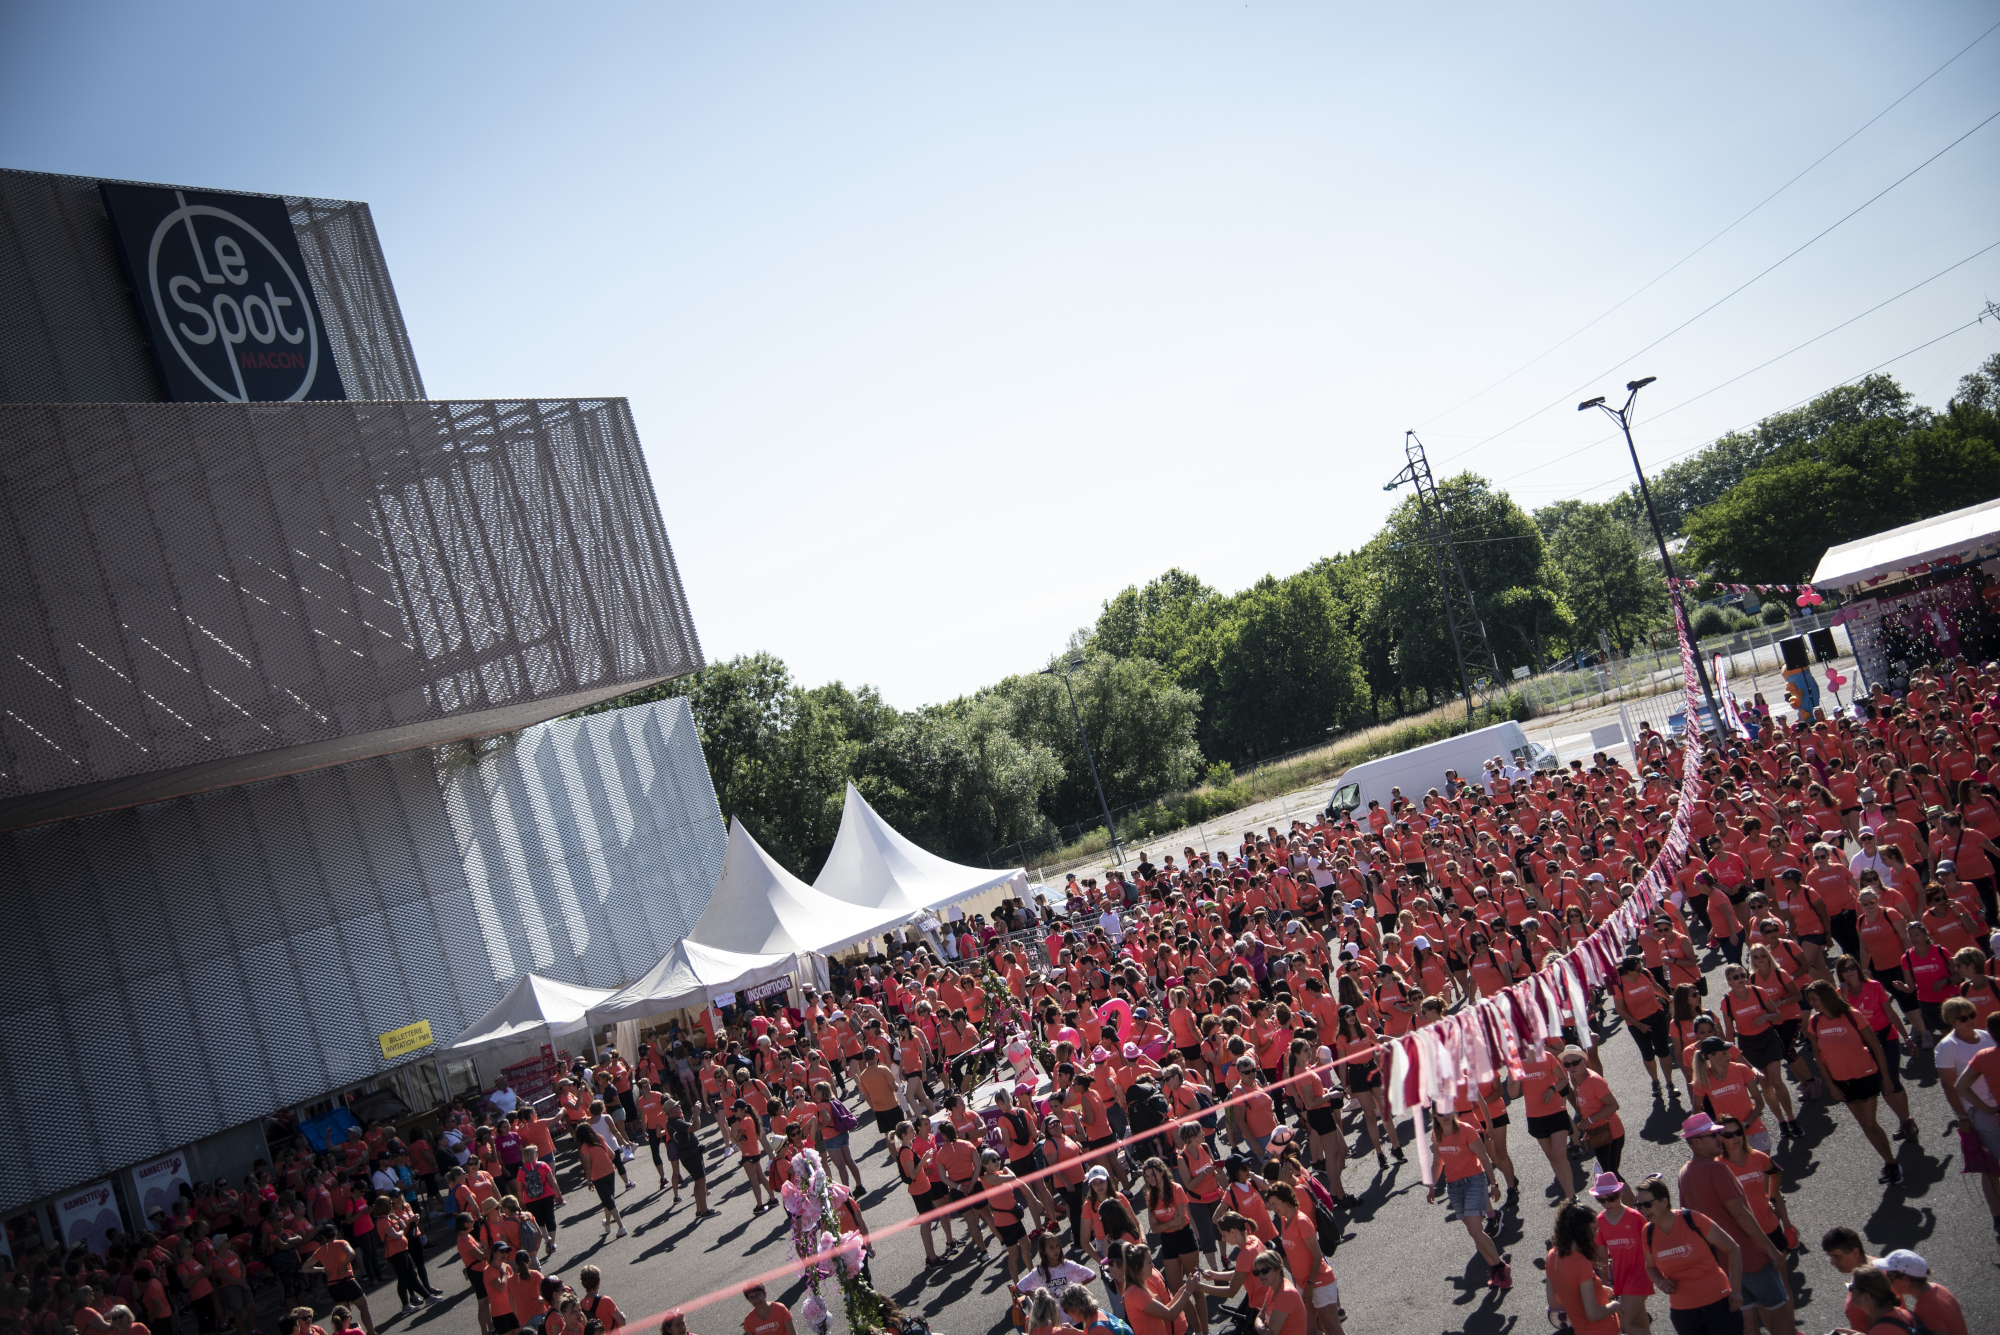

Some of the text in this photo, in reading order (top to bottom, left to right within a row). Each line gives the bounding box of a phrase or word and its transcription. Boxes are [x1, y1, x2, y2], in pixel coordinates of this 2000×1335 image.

[175, 191, 249, 285] Le
[169, 275, 305, 402] Spot
[241, 351, 305, 369] MACON
[747, 976, 791, 1002] INSCRIPTIONS
[386, 1038, 416, 1053] INVITATION
[419, 1033, 431, 1042] PMR
[389, 1027, 423, 1043] BILLETTERIE
[138, 1158, 175, 1179] GAMBETTES
[63, 1189, 101, 1212] GAMBETTES
[1047, 1277, 1067, 1288] NASA
